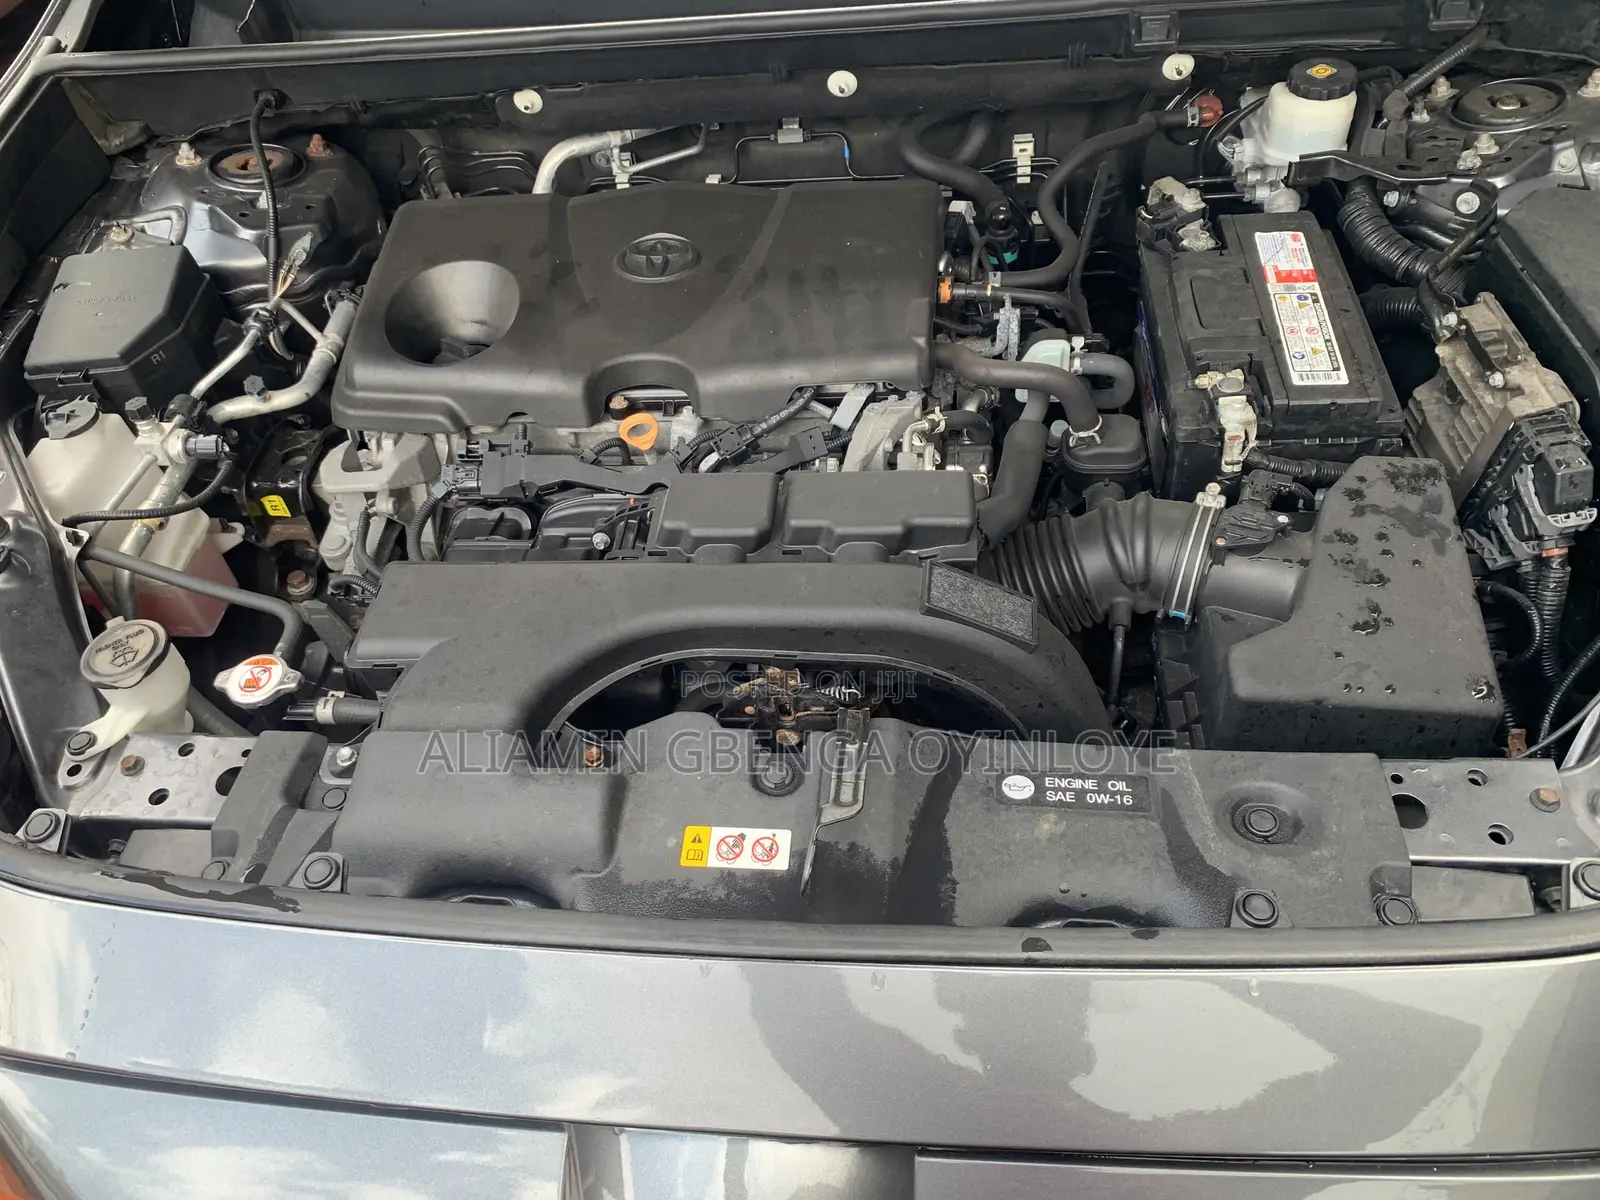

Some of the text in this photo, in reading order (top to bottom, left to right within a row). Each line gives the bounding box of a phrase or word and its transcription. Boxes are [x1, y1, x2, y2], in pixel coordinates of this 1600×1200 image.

[150, 349, 166, 366] R1
[1045, 778, 1132, 791] ENGINE OIL
[1046, 791, 1133, 805] SAE 0W-16
